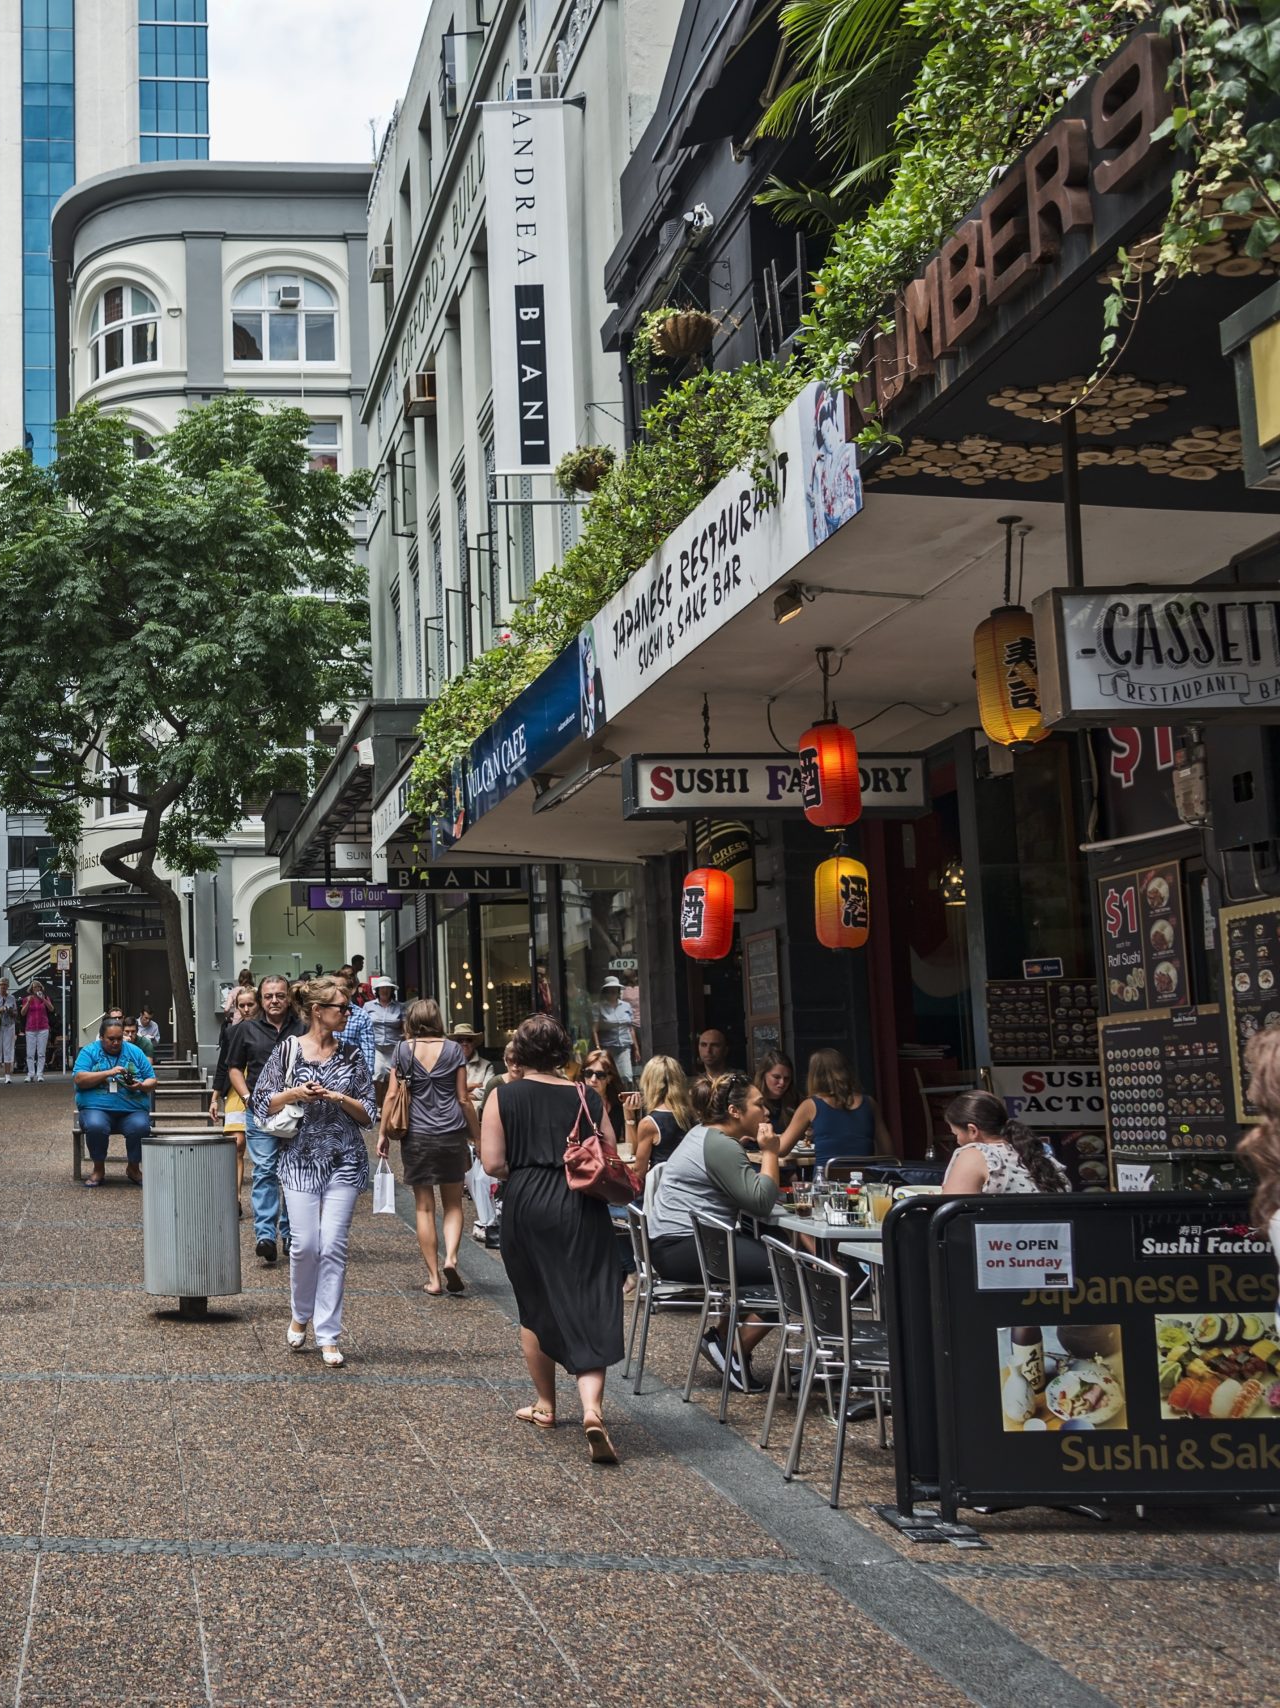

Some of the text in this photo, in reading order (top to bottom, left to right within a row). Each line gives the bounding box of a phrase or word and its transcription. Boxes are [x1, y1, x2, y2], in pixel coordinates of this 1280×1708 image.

[1091, 32, 1175, 194] 9
[512, 111, 538, 266] ANDREA
[400, 237, 446, 378] GIFFORD'S
[519, 307, 545, 445] BIANI
[612, 563, 673, 660] JAPANESE
[638, 554, 741, 675] SUSHI & SAKE BAR
[1126, 675, 1280, 702] RESTAURANT BA
[466, 747, 501, 804] VULCAN
[501, 723, 527, 775] CAFE
[650, 765, 912, 802] SUSHI FAORY
[32, 898, 81, 910] Norfolk House
[1105, 886, 1138, 938] $1
[1108, 951, 1142, 967] Roll Sushi
[1022, 1071, 1101, 1094] SUSH
[1003, 1096, 1104, 1119] FACTO
[986, 1256, 1063, 1270] on Sunday
[988, 1239, 1058, 1251] We OPEN
[1142, 1236, 1271, 1255] Sushi Factor
[1060, 1432, 1280, 1472] Sushi & Sak
